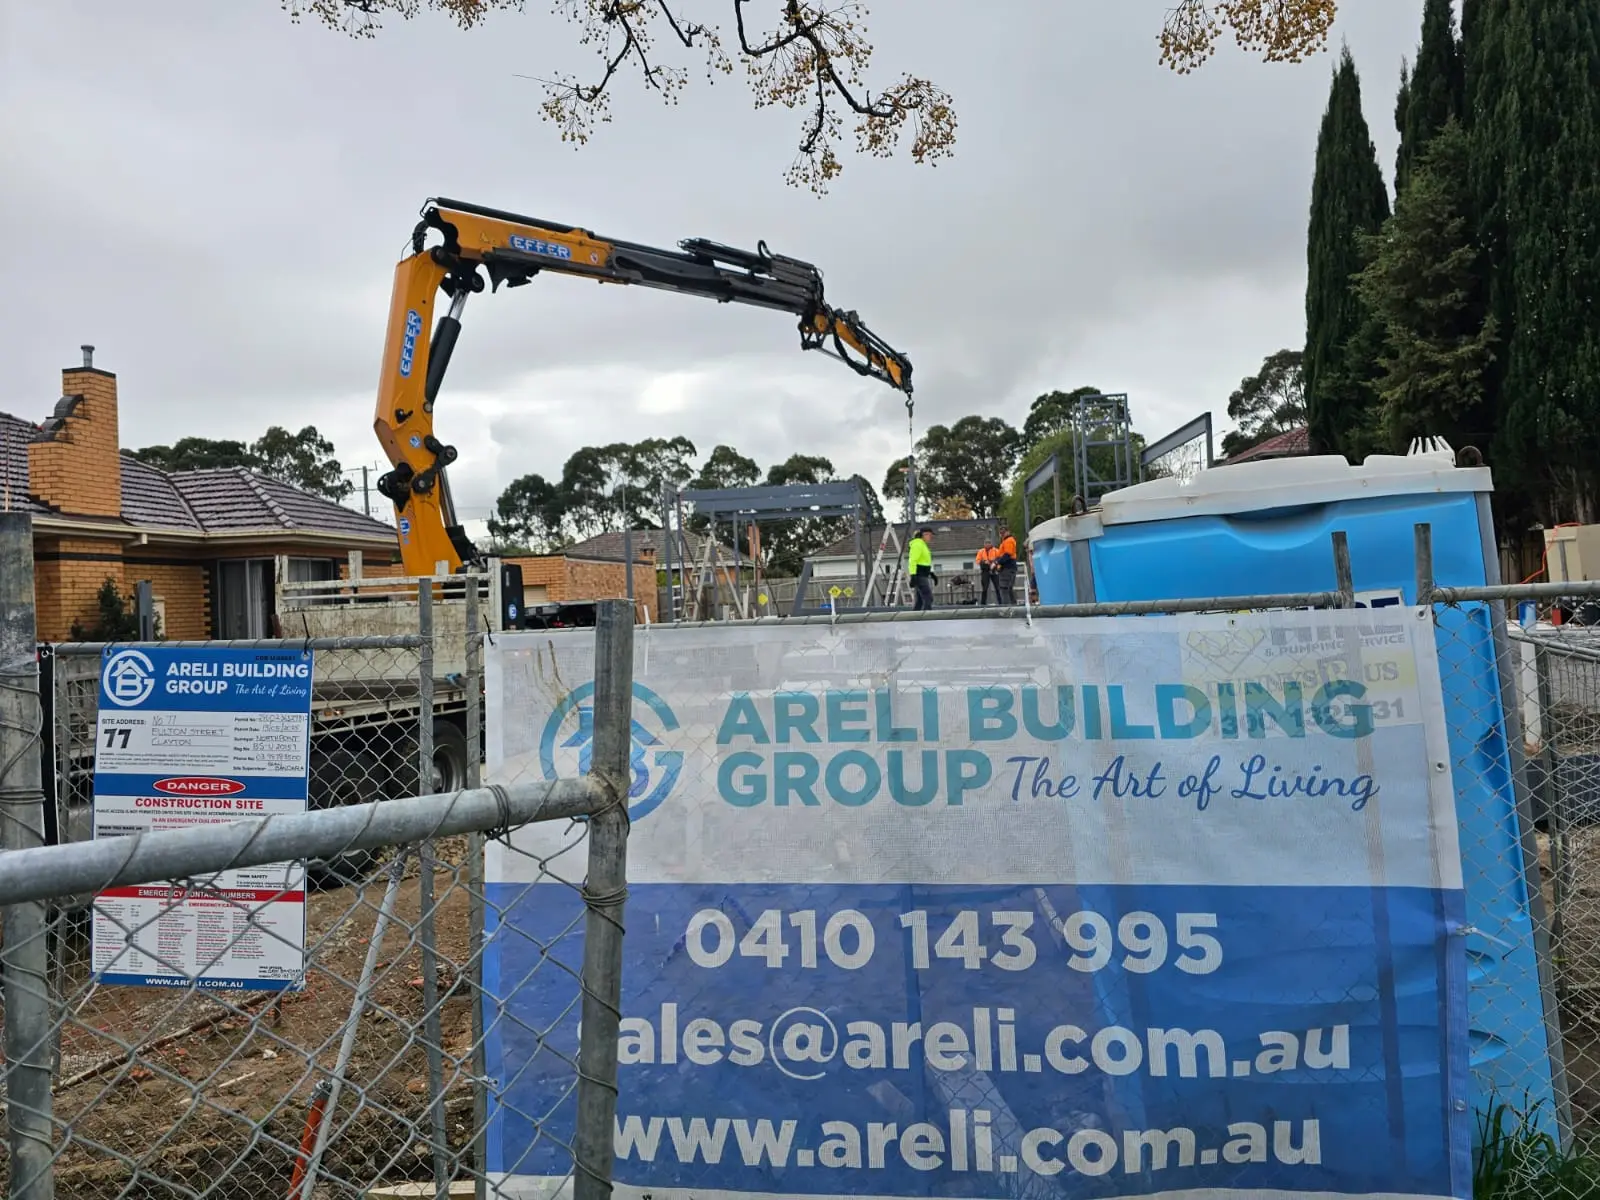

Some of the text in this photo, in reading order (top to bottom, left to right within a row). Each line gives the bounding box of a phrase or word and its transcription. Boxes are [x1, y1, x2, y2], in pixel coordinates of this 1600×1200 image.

[513, 236, 569, 260] EFFER
[401, 310, 418, 373] EFFER
[1279, 640, 1345, 655] PUMPING
[166, 662, 309, 678] ARELI BUILDING
[1363, 660, 1400, 683] US
[165, 680, 307, 698] GROUP The Art of Living
[715, 679, 1377, 746] ARELI BUILDING
[103, 728, 132, 749] 77
[167, 782, 231, 791] DANGER
[716, 749, 1380, 812] GROUP The Art of Living
[135, 798, 264, 810] CONSTRUCTION SITE
[138, 889, 184, 897] EMERGECY
[685, 908, 1223, 975] 0410 143 995
[577, 1002, 1350, 1081] ales@areli.com.au
[612, 1108, 1322, 1177] www.areli.com.au
